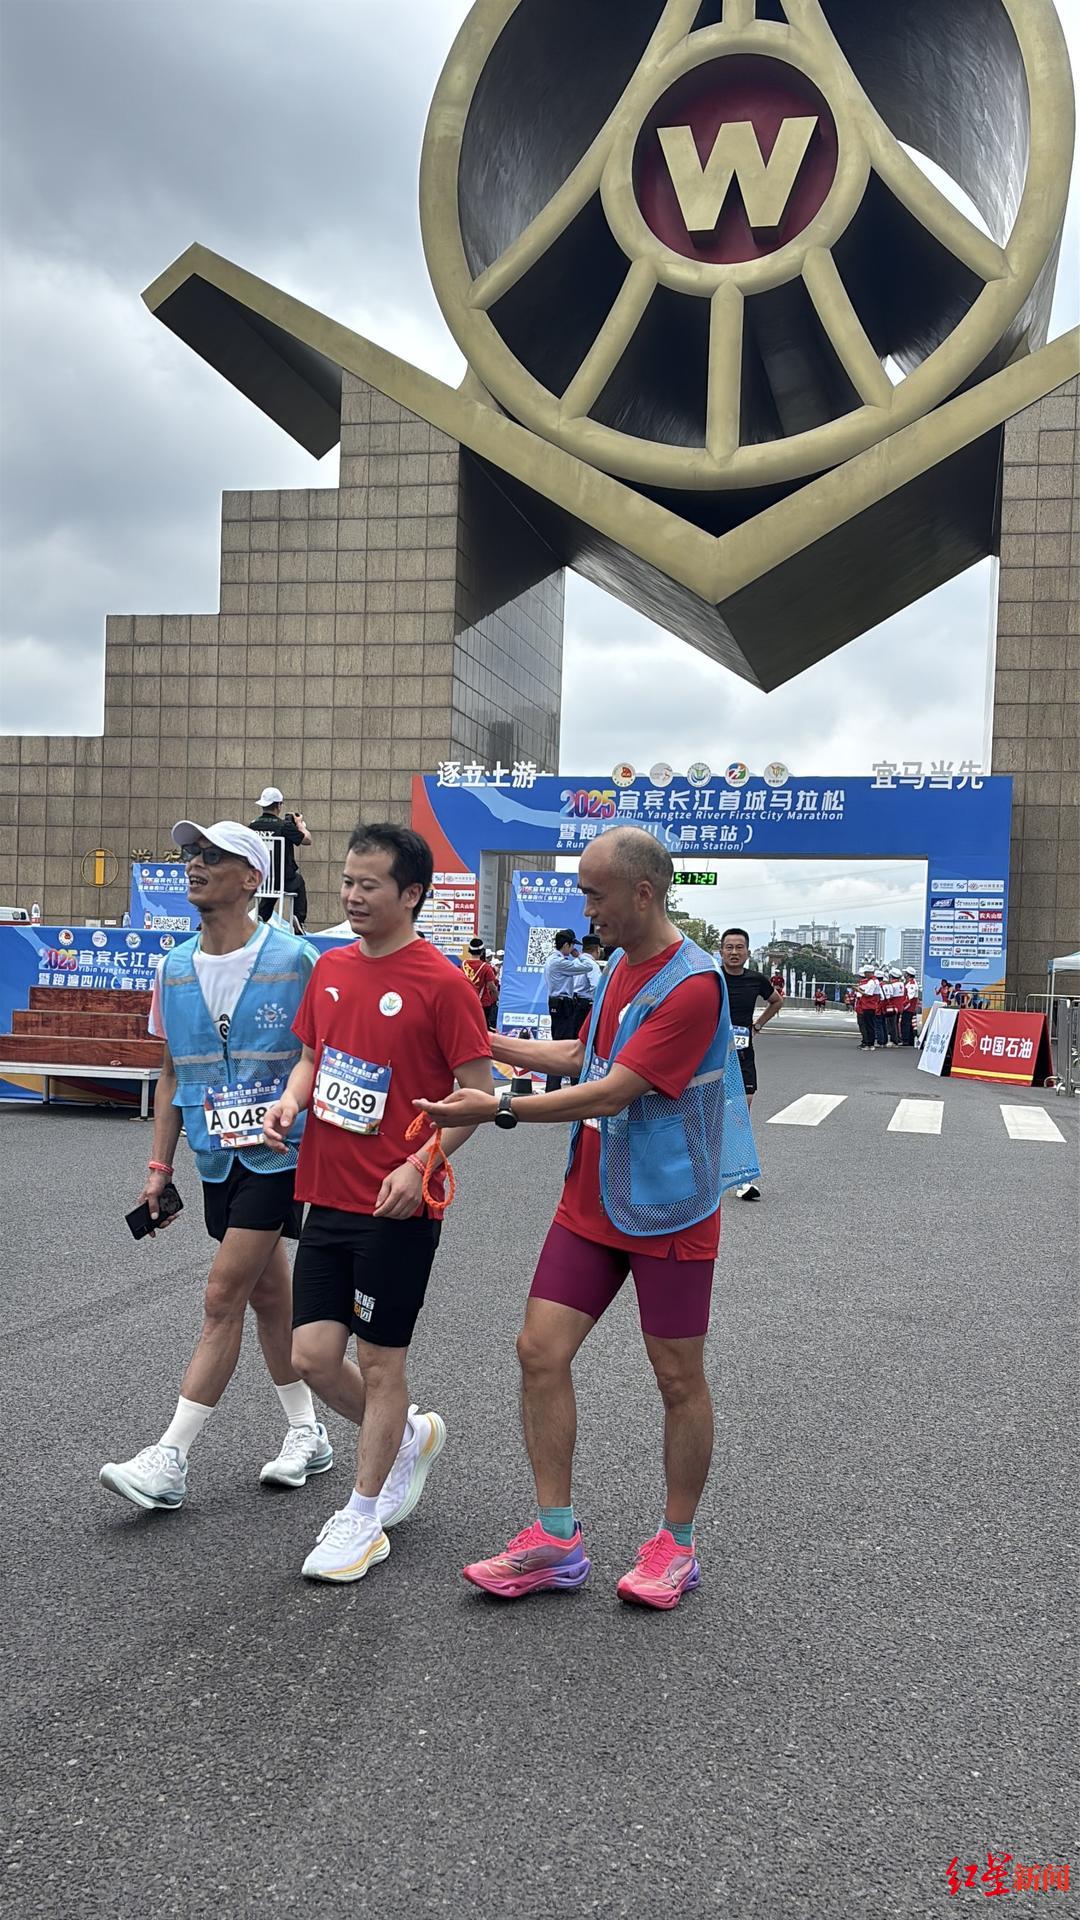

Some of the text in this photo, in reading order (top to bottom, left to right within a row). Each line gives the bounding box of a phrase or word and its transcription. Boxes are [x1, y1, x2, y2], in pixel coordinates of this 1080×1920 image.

[656, 116, 819, 232] W
[871, 760, 984, 790] 宜马当先
[615, 810, 843, 822] Yibin Yangtze River First City Marathon
[558, 823, 753, 844] 暨跑川（宜宾站）
[566, 840, 585, 849] Run
[78, 966, 98, 974] Yibin
[979, 1035, 1033, 1059] 中国石油
[326, 1082, 376, 1114] 0369
[210, 1104, 275, 1130] A 048
